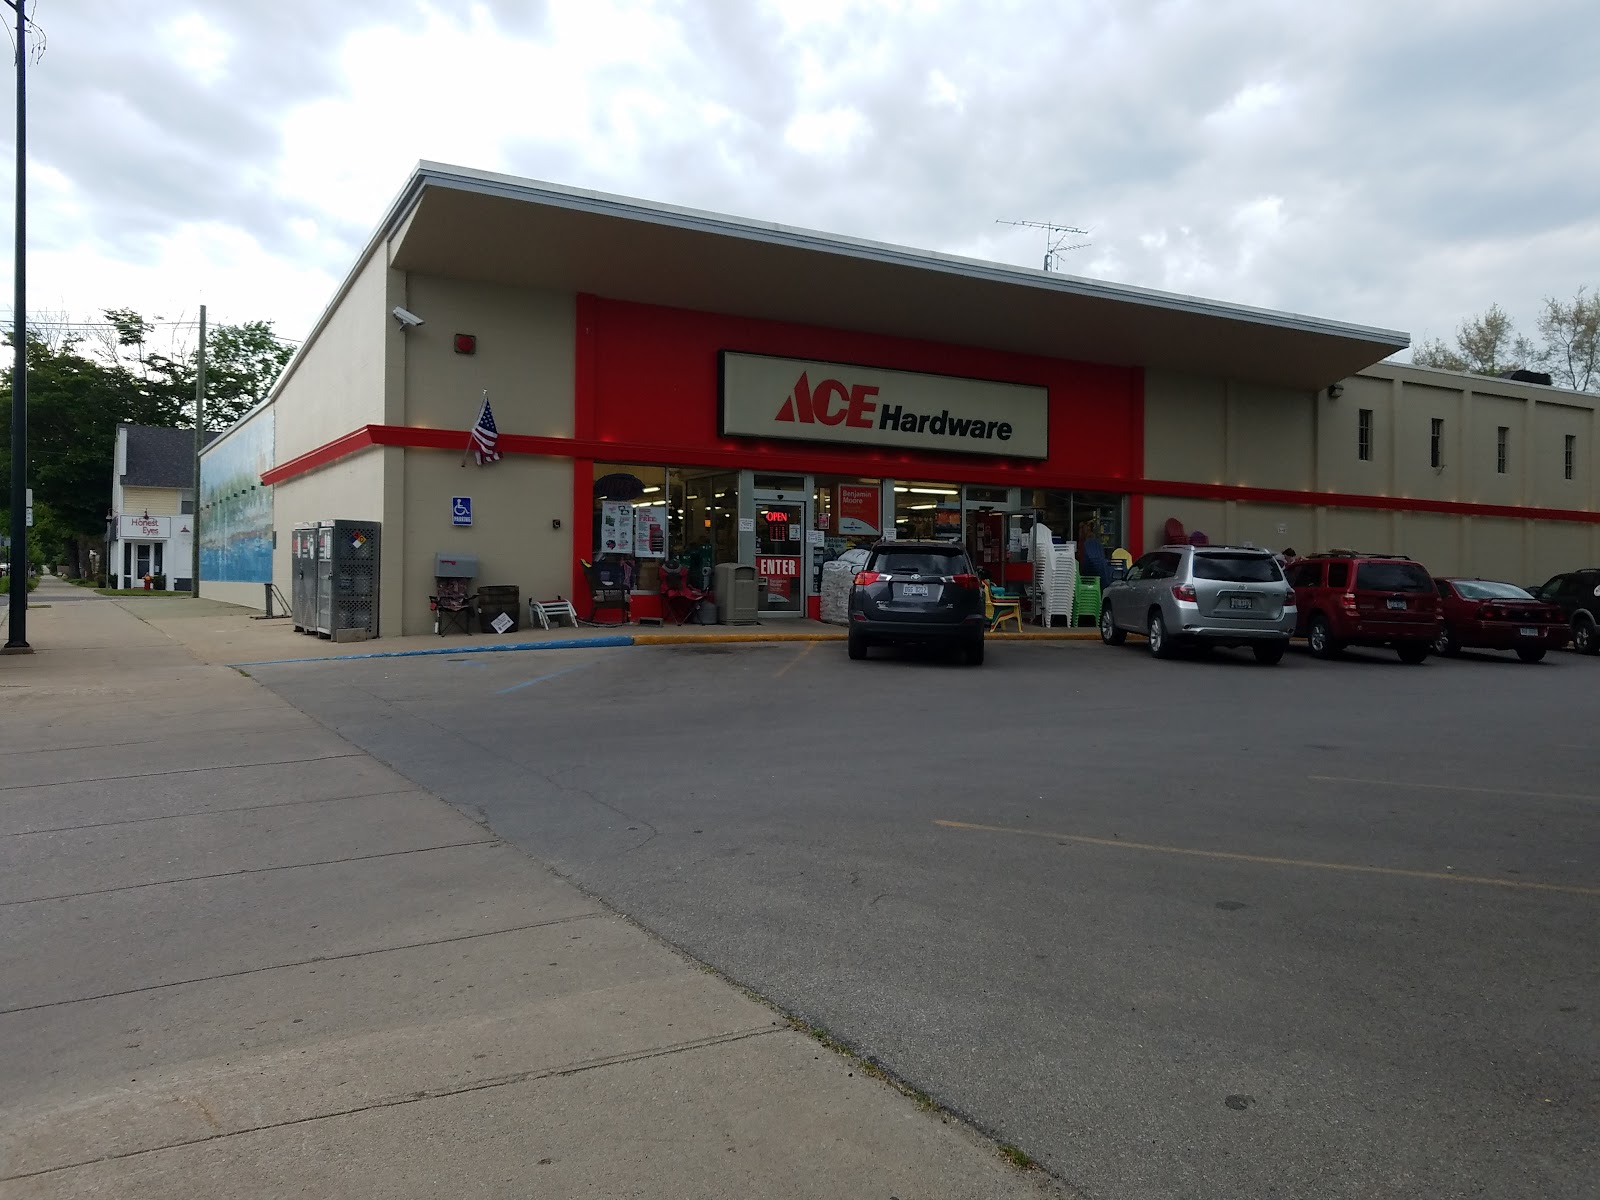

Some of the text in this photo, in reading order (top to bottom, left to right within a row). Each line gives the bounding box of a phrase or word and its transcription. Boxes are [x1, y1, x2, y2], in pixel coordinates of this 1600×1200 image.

[774, 370, 1013, 441] ACE Hardware
[843, 490, 872, 499] Benjamin
[131, 518, 159, 526] Honest
[767, 512, 788, 522] OPEN
[760, 559, 796, 575] ENTER
